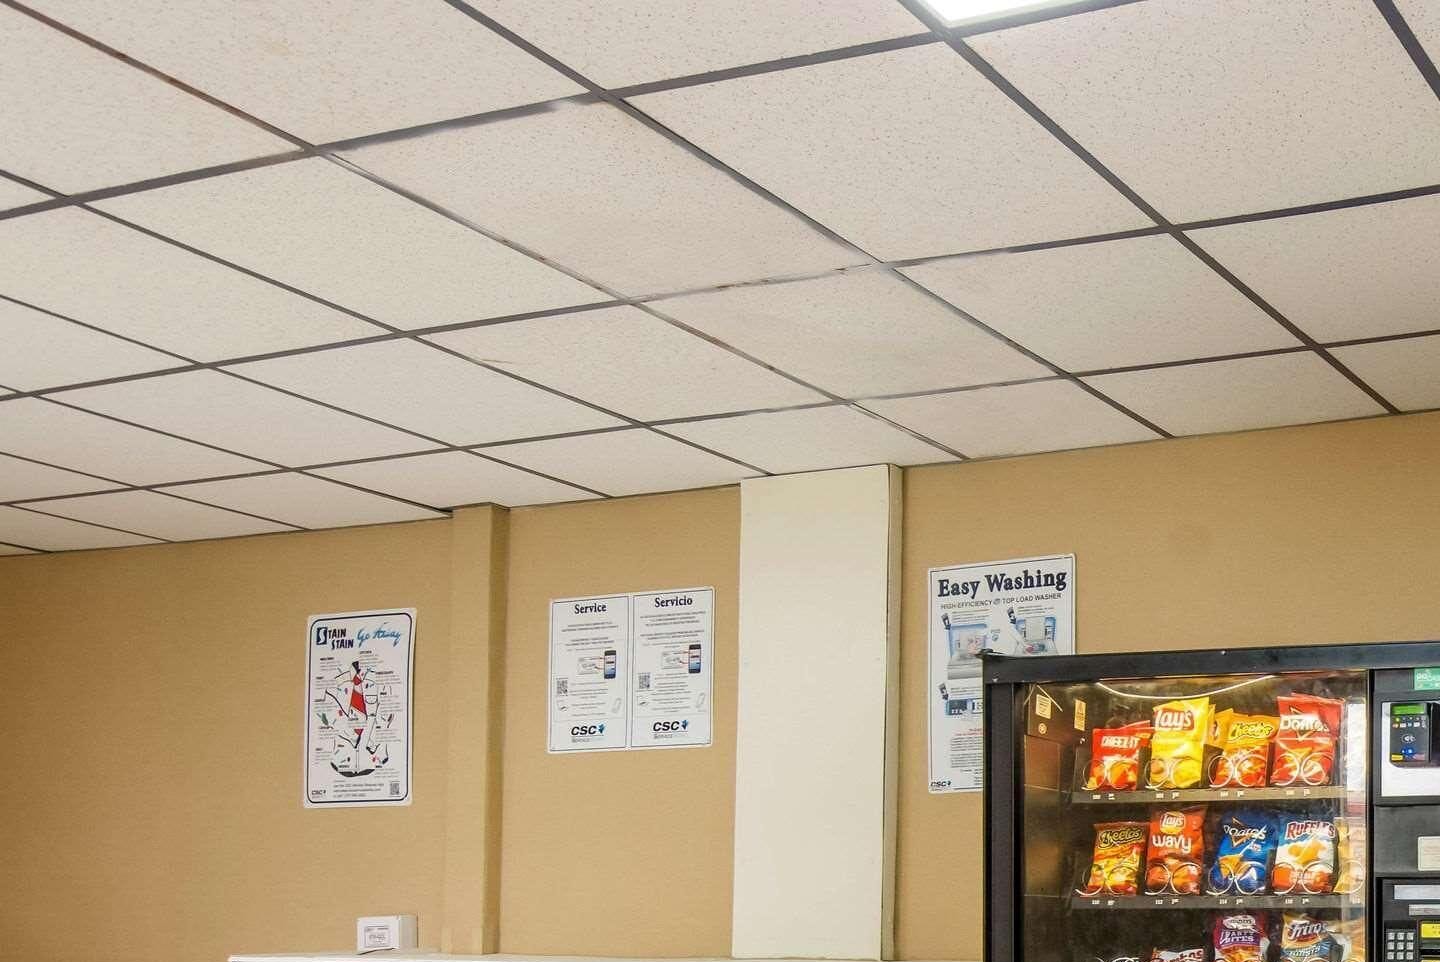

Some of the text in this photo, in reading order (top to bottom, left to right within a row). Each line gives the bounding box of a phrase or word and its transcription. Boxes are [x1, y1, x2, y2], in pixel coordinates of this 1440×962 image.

[937, 569, 1067, 600] Easy Washing
[654, 595, 693, 607] Servicio
[574, 602, 608, 614] Service
[331, 638, 354, 650] STAIN
[571, 725, 598, 736] CSC
[653, 721, 680, 732] CSC
[1152, 834, 1193, 855] wavy
